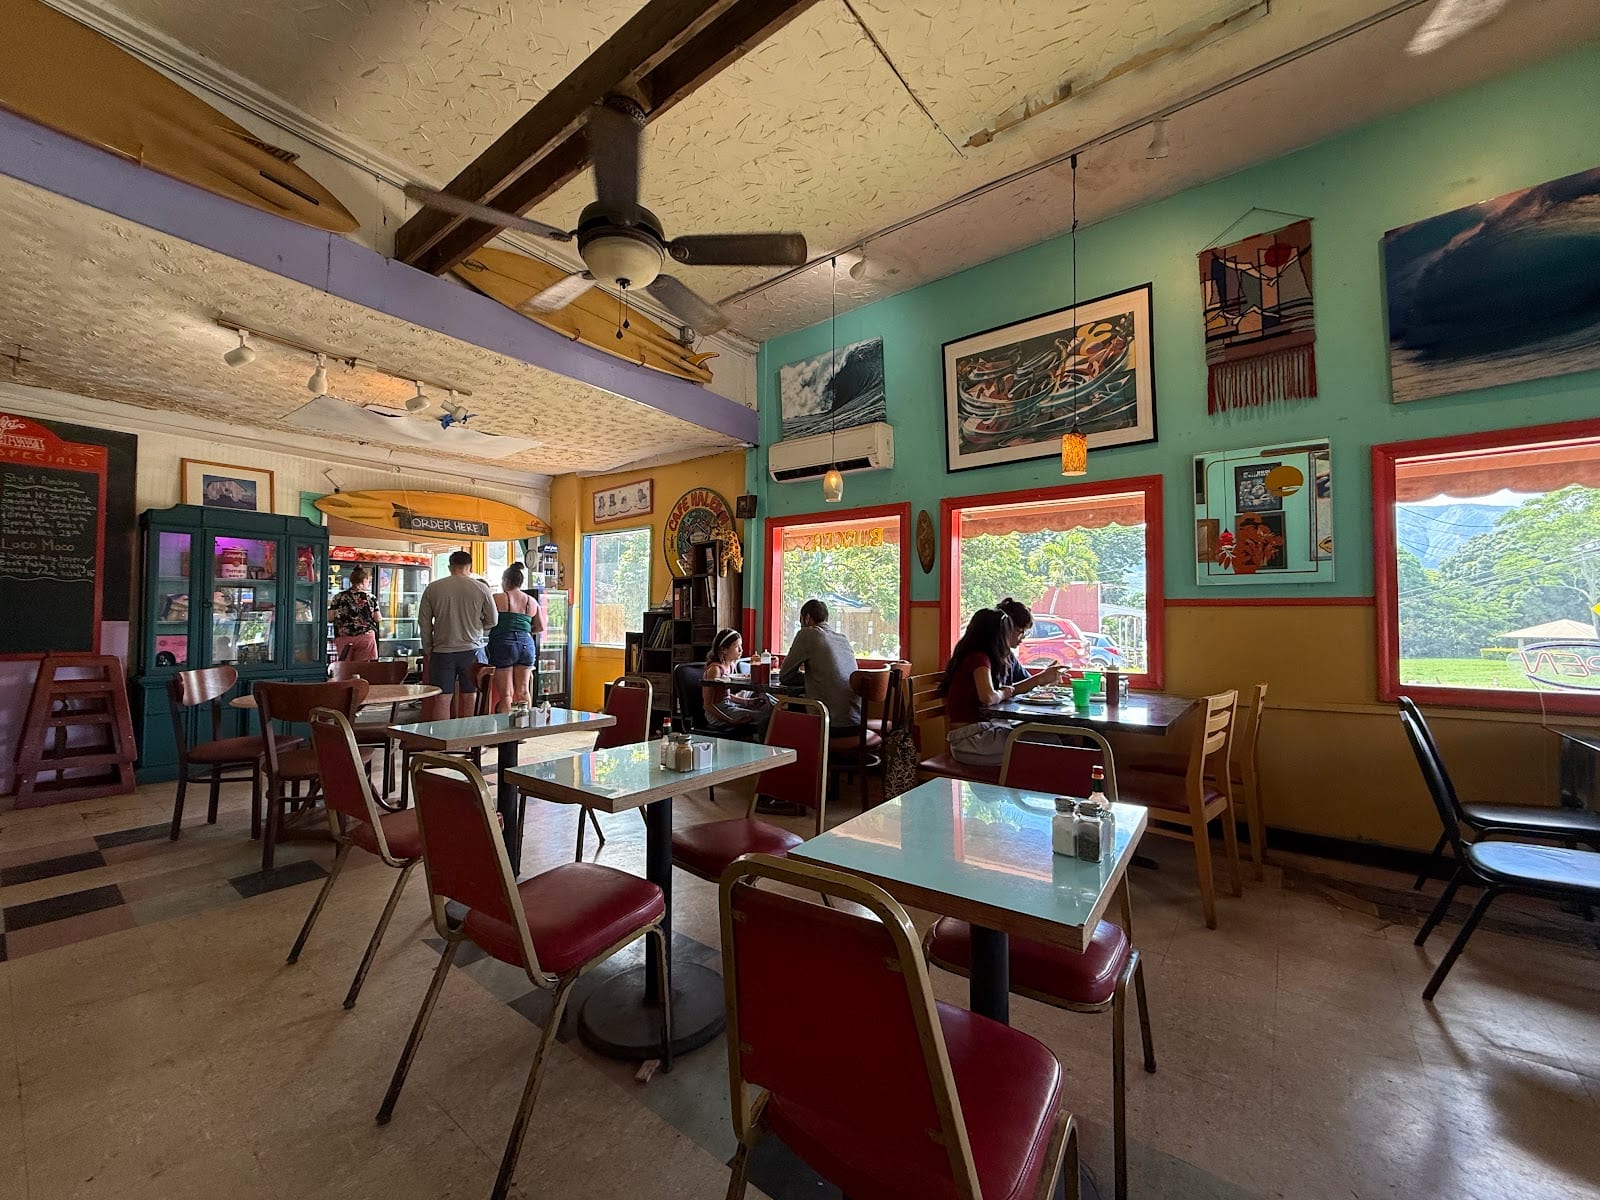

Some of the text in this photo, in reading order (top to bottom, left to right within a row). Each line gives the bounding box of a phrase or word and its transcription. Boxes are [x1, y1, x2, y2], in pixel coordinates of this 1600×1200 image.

[411, 518, 480, 533] ORDER HERE
[2, 538, 75, 551] Loco Moco
